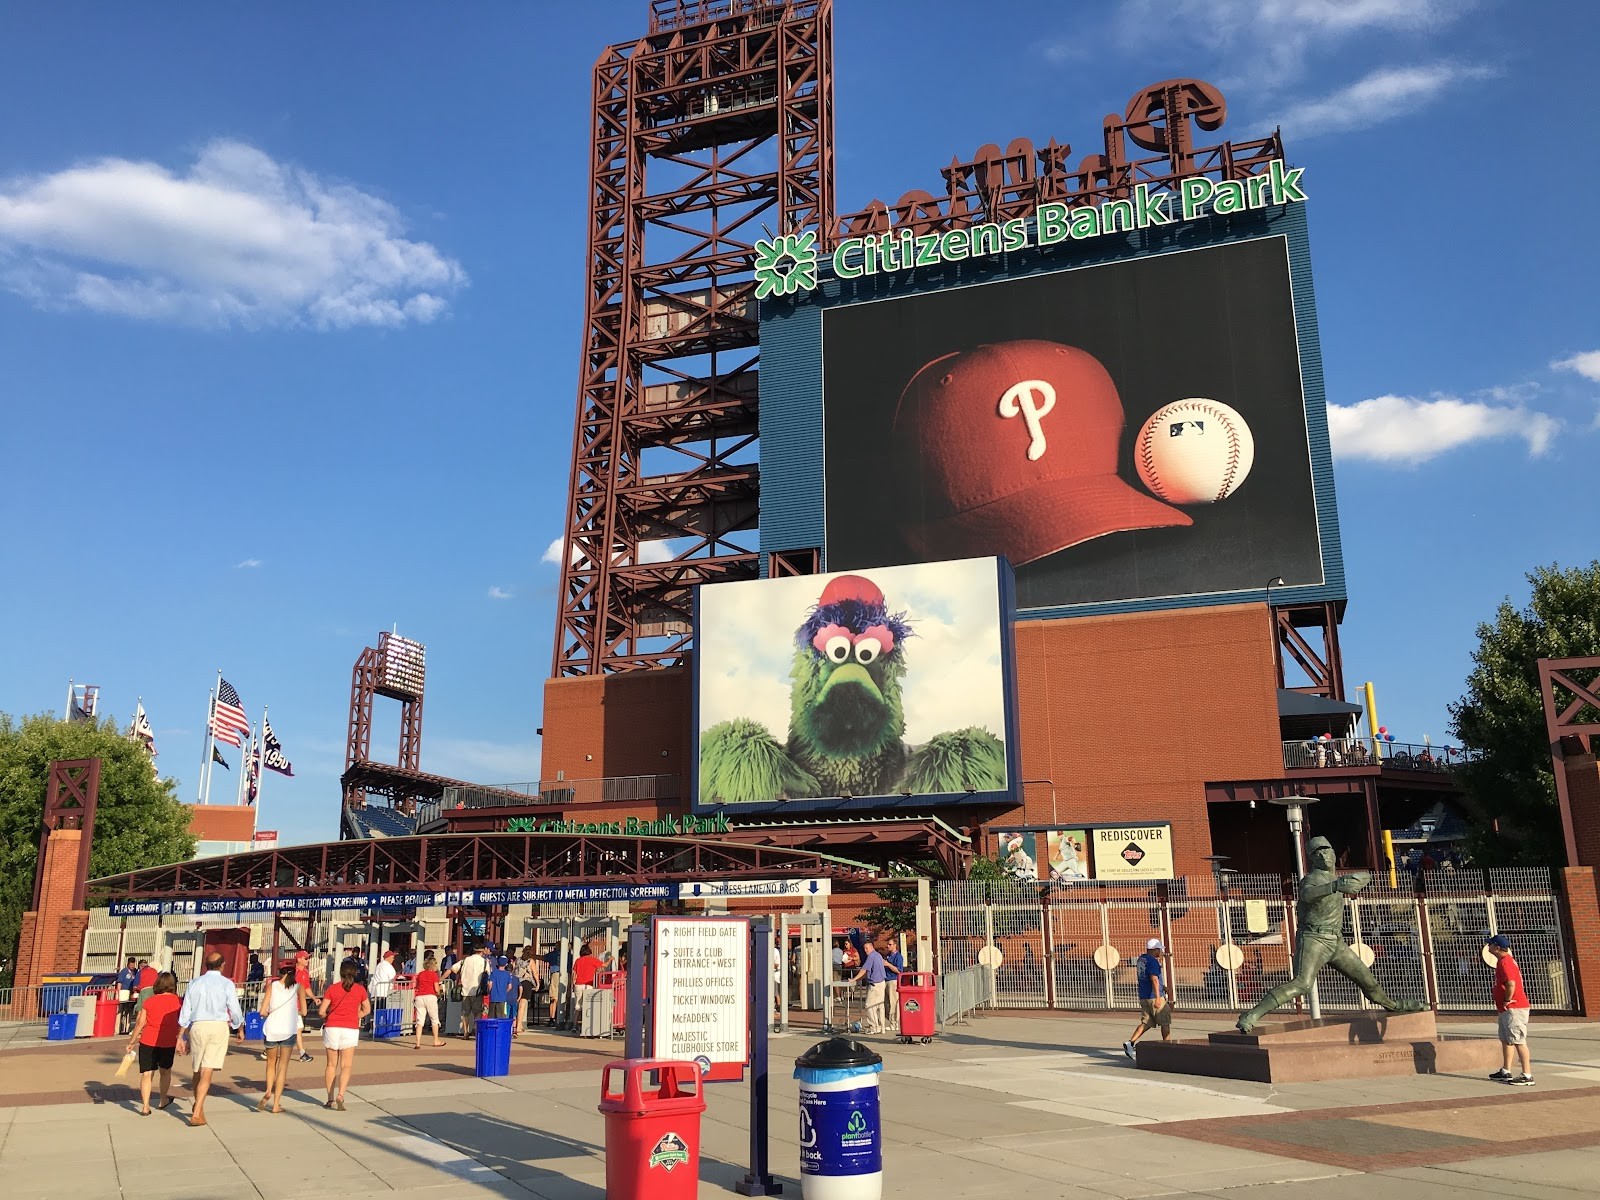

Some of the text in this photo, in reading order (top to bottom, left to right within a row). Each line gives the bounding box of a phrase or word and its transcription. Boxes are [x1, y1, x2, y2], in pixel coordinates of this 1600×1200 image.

[833, 159, 1310, 278] Citizens Bank Park
[999, 379, 1057, 461] P
[625, 814, 679, 836] Bank
[682, 811, 731, 834] Park
[1100, 829, 1163, 842] REDISCOVER
[480, 886, 670, 903] GUESTS ARE SUBJECT TO METAL DETECTION SCREENING
[711, 885, 742, 895] EXPRESS
[779, 883, 800, 893] BAGS
[201, 896, 368, 912] GUESTS ARE SUBJECT TO METAL DETECTION SCREENING
[380, 893, 432, 906] PLEASE REMOVE
[114, 901, 159, 914] PLEASE REMOVE
[674, 927, 737, 937] RIGHT FIELD GATE
[673, 947, 723, 957] SUITE & CLUB
[673, 958, 737, 968] ENTRANCE WEST
[673, 977, 734, 988] PHILLIES OFFICES
[673, 994, 736, 1005] TICKET WINDOWS
[672, 1012, 718, 1024] McFADDEN'S
[672, 1031, 708, 1042] MAJESTIC
[672, 1041, 739, 1053] CLUBHOUSE STORE
